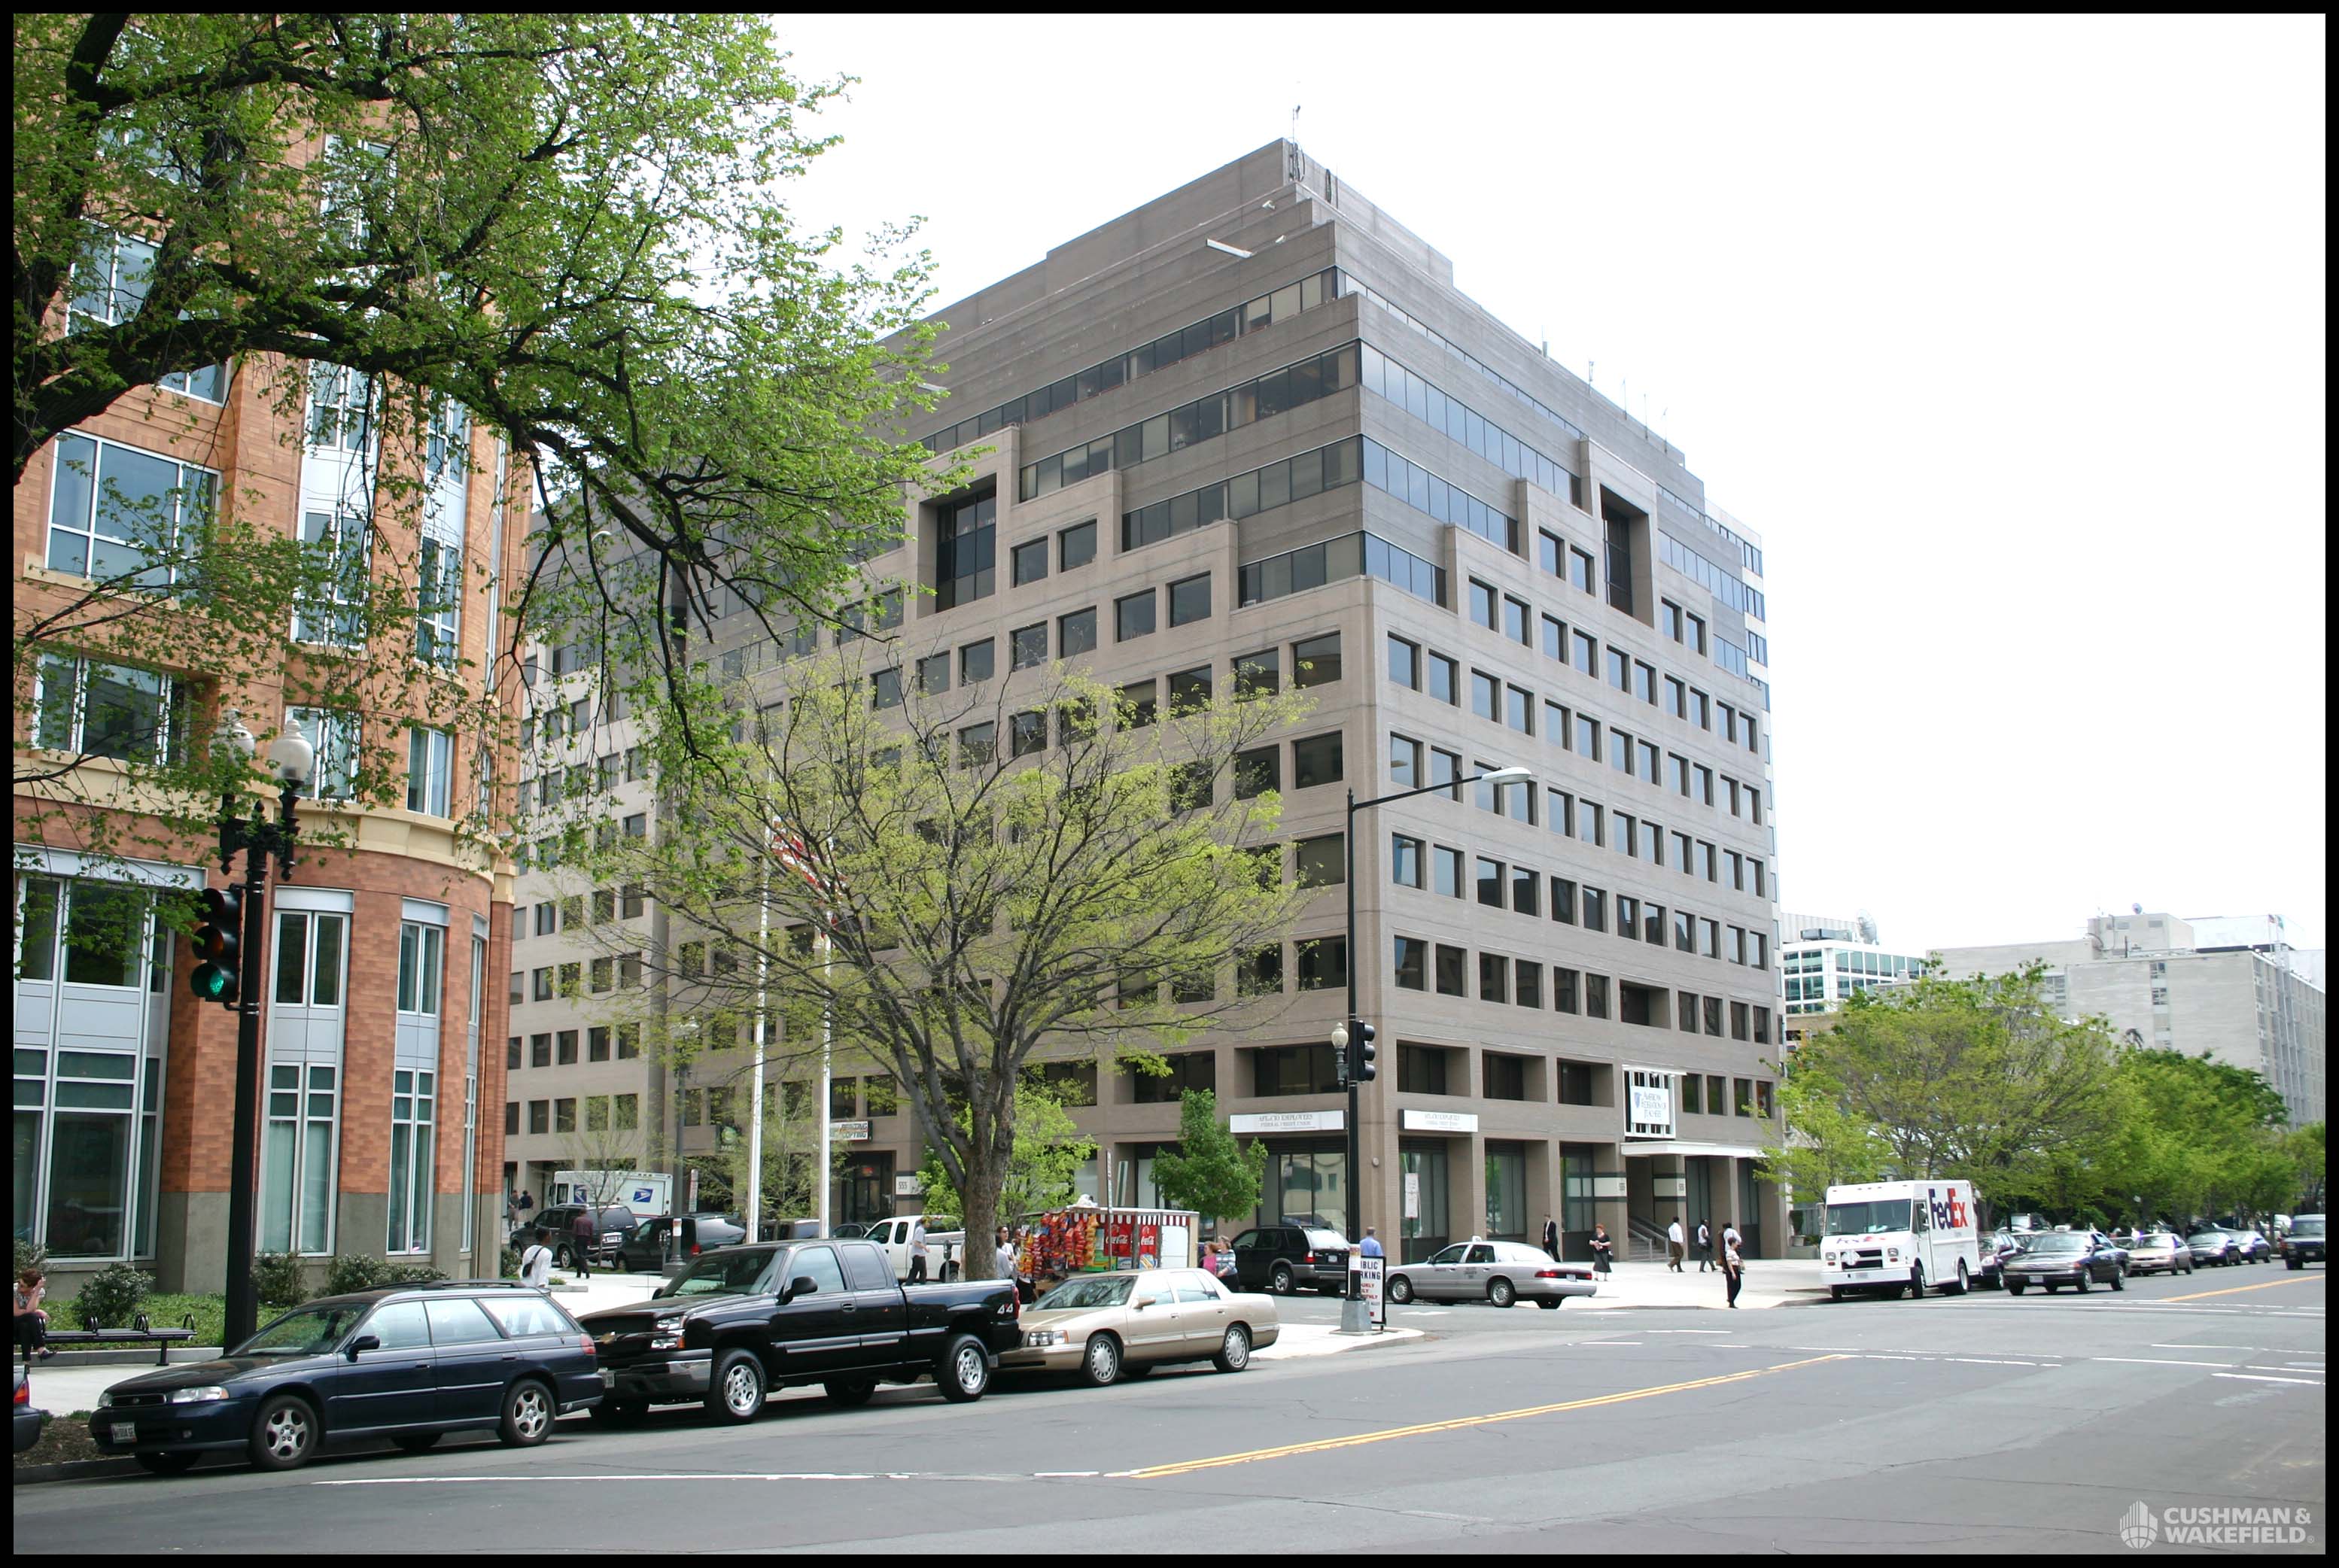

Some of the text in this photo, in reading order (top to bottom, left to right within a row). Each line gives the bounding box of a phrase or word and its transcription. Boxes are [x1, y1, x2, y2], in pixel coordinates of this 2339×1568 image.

[1928, 1188, 1968, 1229] FedEx
[1361, 1260, 1378, 1270] BLIC
[1361, 1270, 1381, 1280] RKING
